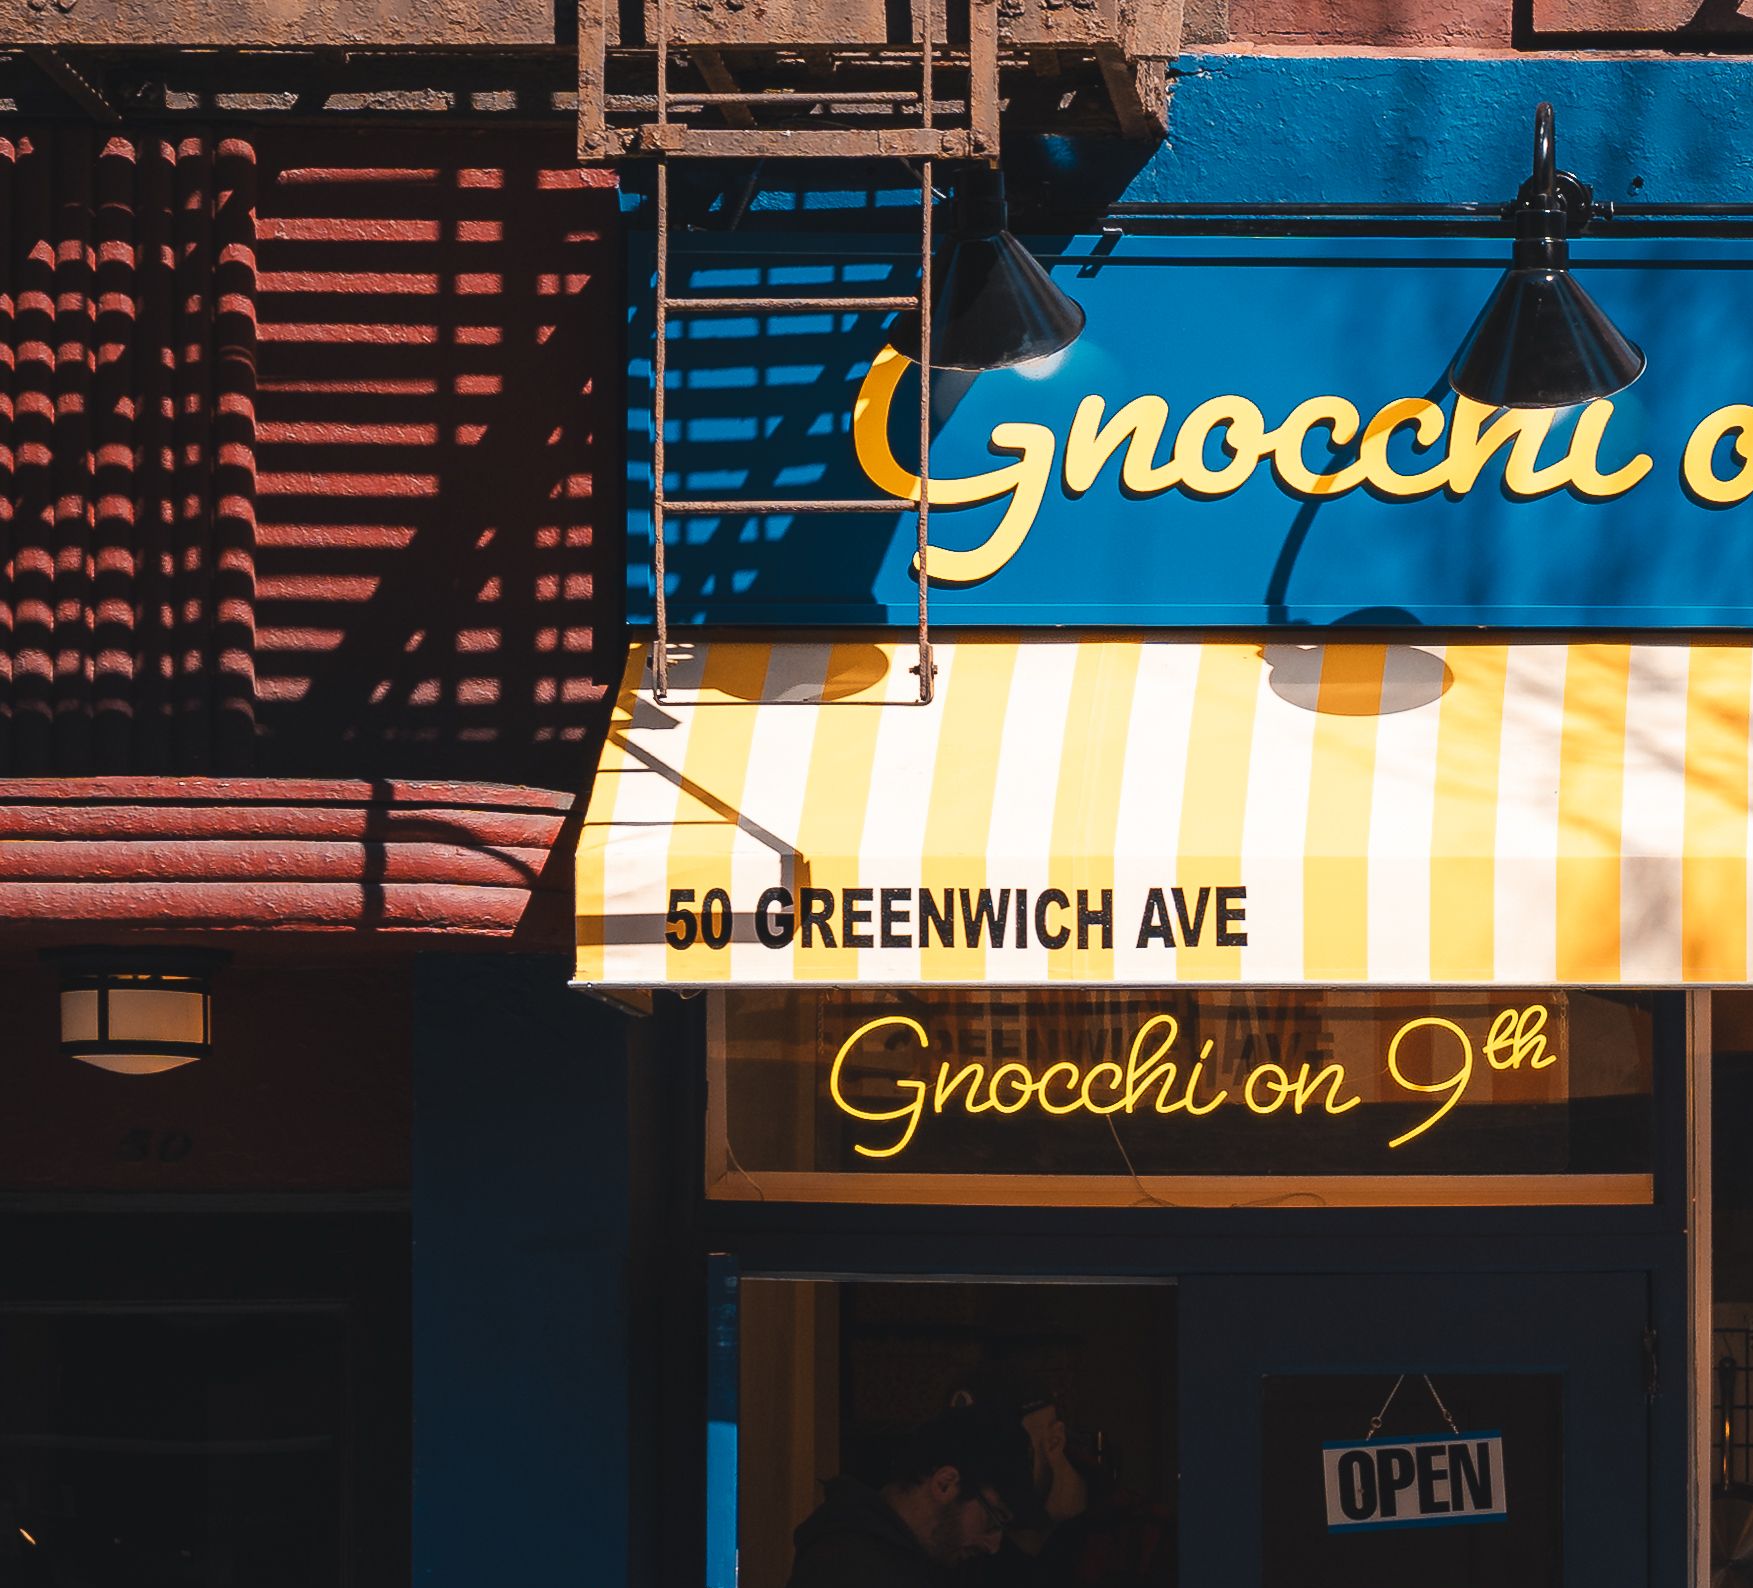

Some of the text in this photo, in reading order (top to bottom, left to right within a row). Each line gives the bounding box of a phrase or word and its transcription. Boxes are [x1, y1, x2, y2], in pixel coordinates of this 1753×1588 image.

[853, 344, 1653, 584] Gnocchi
[665, 885, 1248, 951] 50 GREENWICH AVE
[828, 1002, 1557, 1159] Gnocchi on 9th
[1336, 1440, 1494, 1522] OPEN
